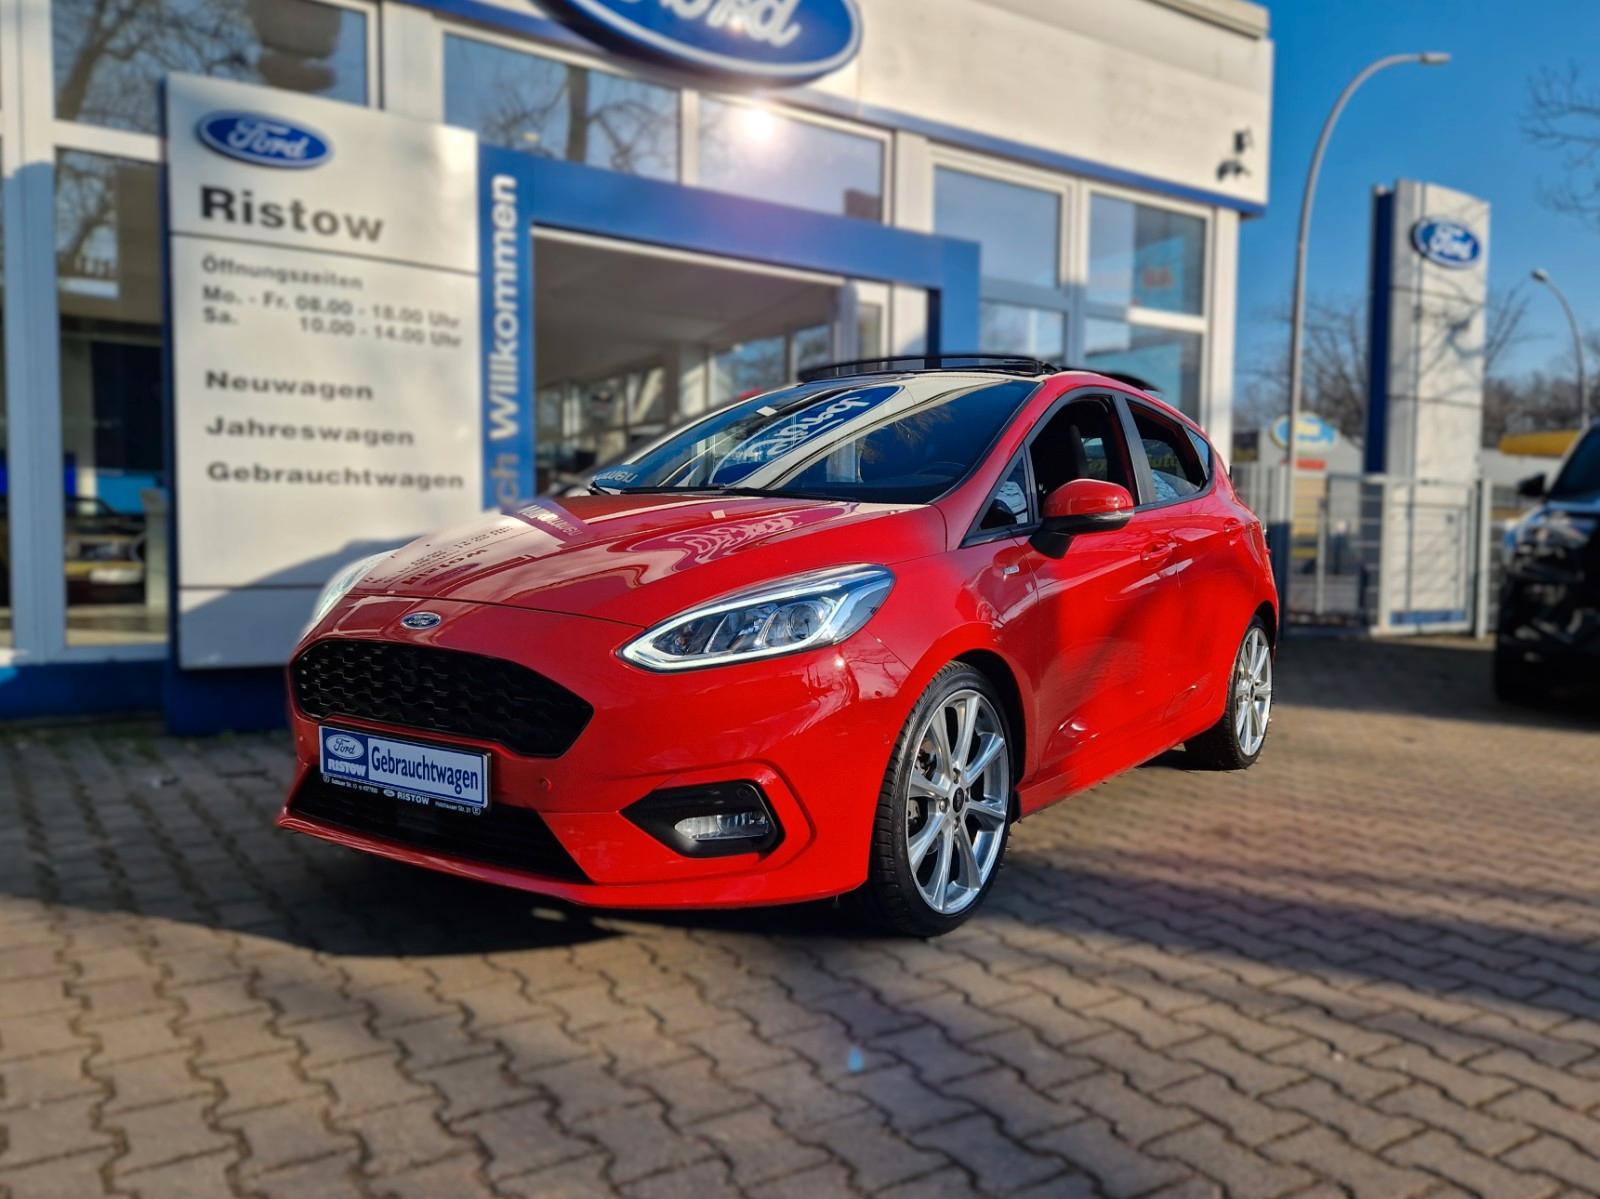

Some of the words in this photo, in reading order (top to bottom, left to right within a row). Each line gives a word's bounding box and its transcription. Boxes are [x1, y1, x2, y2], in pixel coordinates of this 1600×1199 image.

[226, 118, 309, 159] Ford
[201, 184, 384, 241] Ristow
[202, 252, 363, 290] Öffnungszeiten
[203, 285, 242, 305] Mo.
[262, 290, 289, 310] Fr.
[295, 294, 353, 316] 08.00
[428, 309, 460, 329] Uhr
[488, 173, 519, 441] Willkommen
[203, 306, 238, 326] Sa.
[300, 316, 355, 337] 10.00
[374, 323, 425, 345] 14.00
[430, 329, 462, 348] Uhr
[205, 370, 374, 401] Neuwagen
[206, 416, 415, 447] Jahreswagen
[206, 462, 464, 491] Gebrauchtwagen
[333, 737, 356, 755] Ford
[327, 758, 367, 777] RISTOW
[371, 746, 479, 795] Gebrauchtwagen
[397, 791, 430, 806] RISTOW
